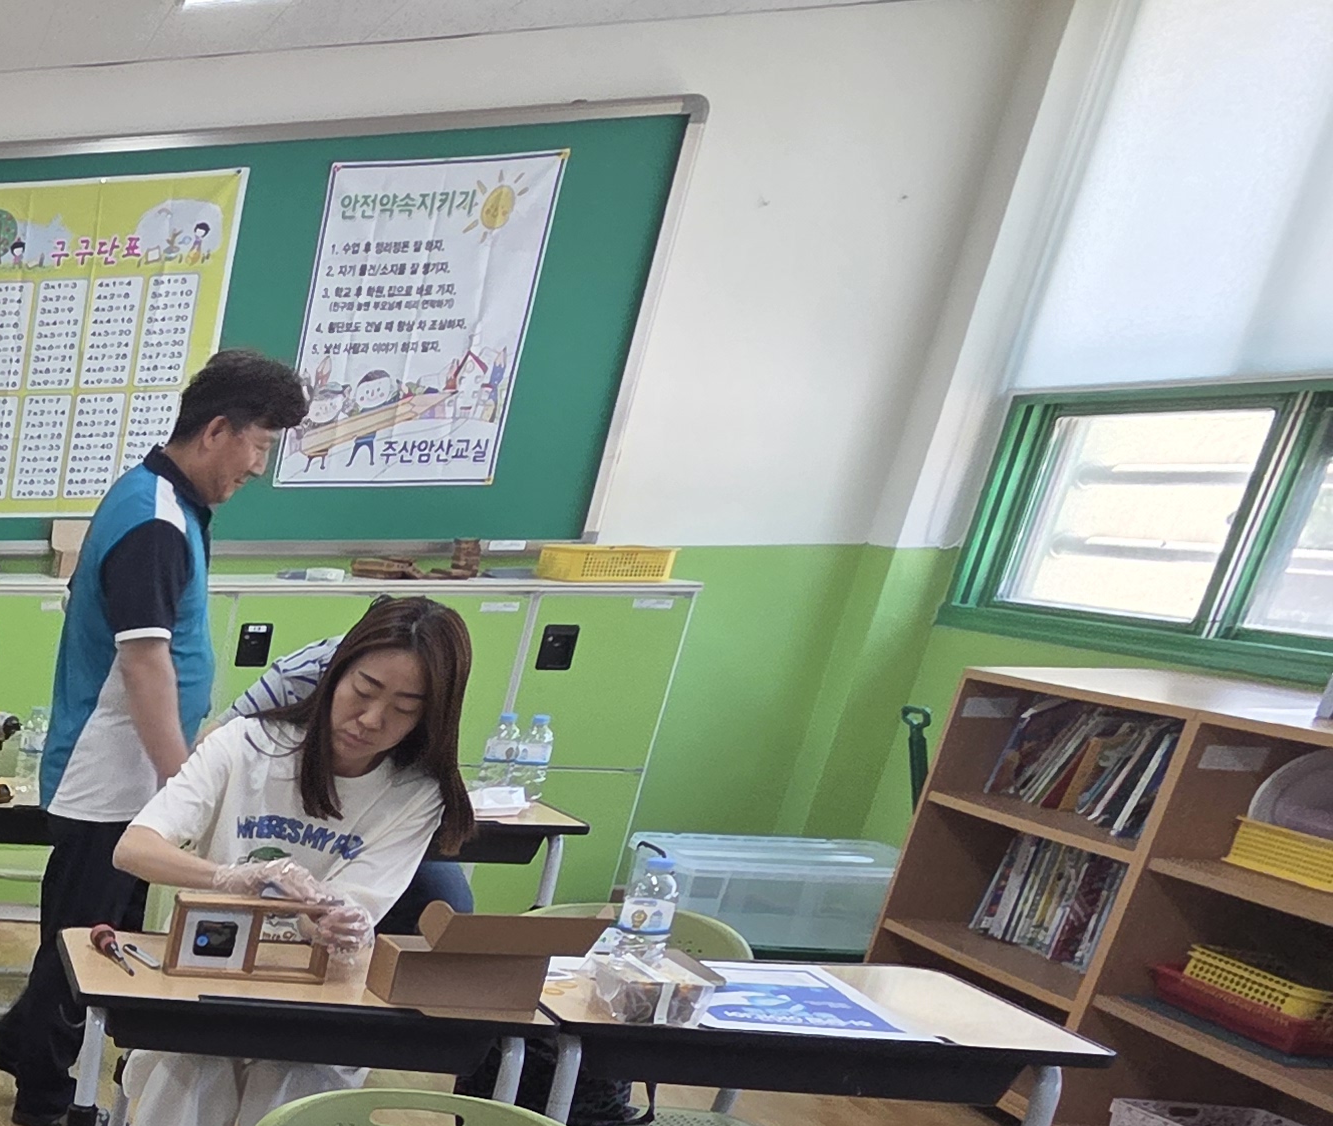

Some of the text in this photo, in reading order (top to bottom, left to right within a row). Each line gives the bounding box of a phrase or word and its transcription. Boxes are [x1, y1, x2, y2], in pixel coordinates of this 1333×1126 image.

[340, 190, 477, 220] 안전약속지키기
[343, 242, 361, 254] 수업
[338, 264, 356, 277] 자기
[380, 438, 489, 465] 주산암산교실
